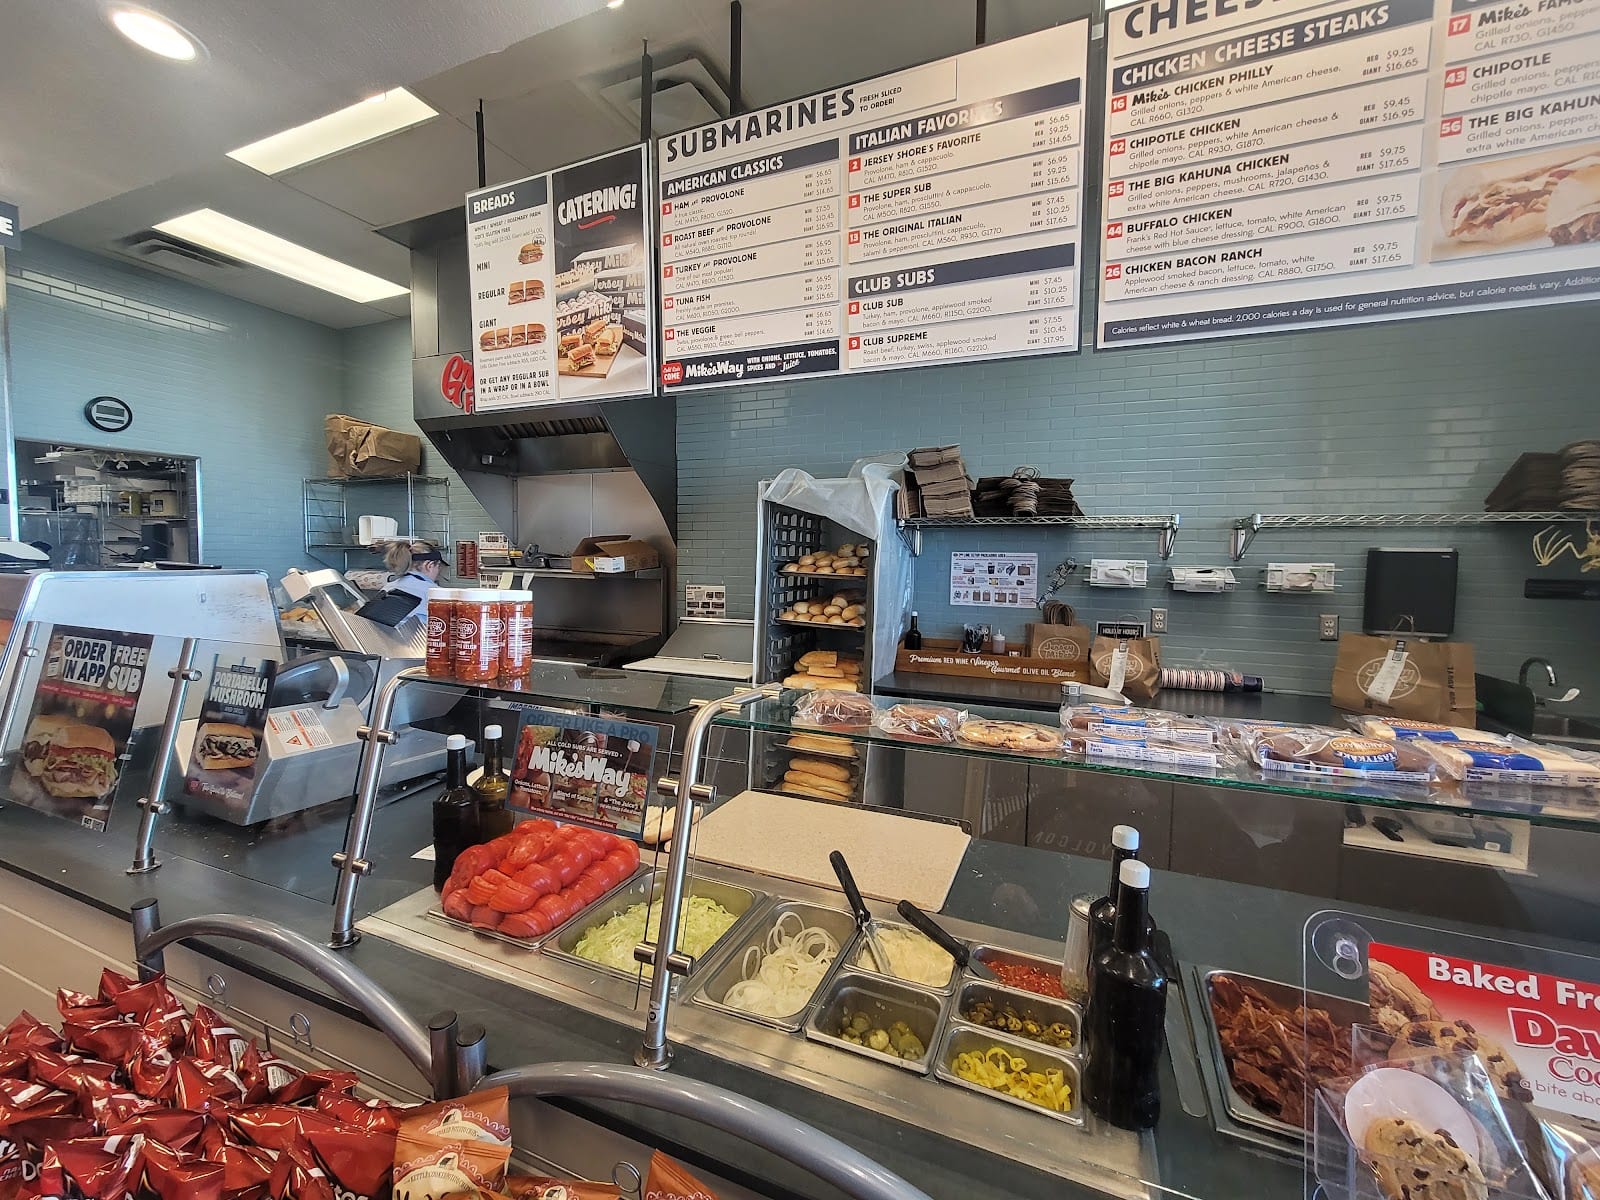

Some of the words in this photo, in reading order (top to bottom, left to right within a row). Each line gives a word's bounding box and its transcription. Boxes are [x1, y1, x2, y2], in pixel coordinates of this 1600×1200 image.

[1452, 21, 1465, 30] 17
[1478, 3, 1532, 27] Mike's
[1122, 50, 1212, 86] CHICKEN
[1215, 29, 1295, 63] CHEESE
[1303, 5, 1389, 43] STEAKS
[1387, 46, 1414, 59] $9.25
[1362, 66, 1381, 76] GIANT
[1386, 58, 1418, 72] $16.65
[1447, 72, 1465, 82] 43
[1472, 52, 1551, 78] CHIPOTLE
[860, 93, 879, 103] FRESH
[881, 87, 902, 98] SLICED
[1112, 101, 1125, 110] 16
[1132, 89, 1170, 106] Mike's
[1174, 76, 1224, 96] CHICKEN
[1229, 65, 1274, 84] PHILLY
[1131, 105, 1156, 117] Grilled
[1159, 100, 1186, 111] onions,
[1189, 91, 1222, 105] peppers
[1235, 84, 1258, 94] white
[1262, 75, 1302, 88] American
[1306, 65, 1341, 78] cheese.
[860, 104, 868, 112] TO
[870, 98, 895, 110] ORDER!
[1384, 97, 1410, 109] $9.45
[667, 89, 855, 162] SUBMARINES
[1360, 116, 1379, 124] GIANT
[1382, 109, 1414, 122] $16.95
[1441, 121, 1461, 133] 56
[1469, 115, 1499, 129] THE
[1505, 107, 1533, 122] BIG
[855, 124, 912, 150] ITALIAN
[1111, 142, 1125, 152] 42
[1130, 131, 1185, 148] CHIPOTLE
[1190, 119, 1241, 137] CHICKEN
[864, 153, 894, 167] JERSEY
[897, 144, 934, 160] SHORE'S
[937, 133, 981, 150] FAVORITE
[667, 169, 727, 196] AMERICAN
[731, 156, 783, 180] CLASSICS
[1109, 184, 1123, 195] 55
[1128, 180, 1150, 191] THE
[1154, 175, 1175, 187] BIG
[1179, 165, 1231, 182] KAHUNA
[1236, 154, 1289, 172] CHICKEN
[473, 191, 515, 215] BREADS
[558, 184, 637, 226] CATERING!
[675, 201, 689, 211] HAM
[701, 188, 745, 204] PROVOLONE
[864, 194, 880, 204] THE
[883, 188, 911, 200] SUPER
[914, 183, 932, 193] SUB
[675, 232, 695, 242] ROAST
[698, 228, 714, 237] BEEF
[727, 216, 771, 231] PROVOLONE
[863, 229, 880, 239] THE
[883, 222, 925, 236] ORIGINAL
[928, 214, 962, 228] ITALIAN
[1108, 226, 1121, 236] 44
[1127, 217, 1178, 233] BUFFALO
[1183, 208, 1232, 224] CHICKEN
[477, 262, 490, 271] MINI
[676, 263, 700, 274] TURKEY
[713, 252, 757, 267] PROVOLONE
[1106, 268, 1120, 277] 26
[1125, 260, 1172, 275] CHICKEN
[1176, 255, 1216, 269] BACON
[1222, 248, 1263, 262] RANCH
[854, 276, 891, 294] CLUB
[897, 269, 935, 288] SUBS
[478, 288, 505, 300] REGULAR
[676, 296, 693, 305] TUNA
[696, 294, 710, 302] FISH
[851, 304, 856, 312] 8
[863, 301, 883, 310] CLUB
[887, 298, 904, 307] SUB
[1112, 326, 1137, 335] Calories
[1139, 323, 1159, 332] reflect
[1161, 321, 1180, 330] white
[1182, 319, 1186, 327] &
[1189, 318, 1210, 327] wheat
[1212, 315, 1233, 325] bread.
[1236, 312, 1260, 323] 2,000
[1263, 309, 1290, 319] calories
[1299, 307, 1313, 317] day
[1316, 306, 1322, 314] is
[1324, 303, 1343, 313] used
[1345, 302, 1356, 311] for
[1358, 298, 1388, 312] general
[1390, 295, 1424, 306] nutrition
[1427, 291, 1456, 302] advice,
[1459, 288, 1474, 298] but
[1477, 286, 1506, 296] calorie
[1509, 283, 1536, 293] needs
[1539, 281, 1562, 292] vary.
[479, 319, 497, 328] GIANT
[677, 329, 689, 337] THE
[691, 326, 716, 335] VEGGIE
[851, 340, 857, 348] 9
[863, 336, 884, 346] CLUB
[887, 331, 928, 344] SUPREME
[64, 639, 106, 662] ORDER
[114, 645, 146, 666] FREE
[910, 654, 942, 663] Premium
[970, 656, 999, 668] Vinegar
[64, 659, 74, 680] IN
[77, 662, 105, 683] APP
[108, 665, 141, 692] SUB
[213, 672, 268, 692] PORTABELLA
[991, 665, 1020, 675] Gourmet
[1040, 668, 1049, 676] OIL
[1051, 668, 1077, 677] Blend
[210, 686, 266, 709] MUSHROOM
[527, 714, 571, 726] ORDER
[574, 718, 604, 732] LIKE
[609, 723, 617, 734] A
[619, 727, 649, 742] PRO
[598, 749, 619, 758] SERVED
[1338, 751, 1397, 763] TASTYKAKE
[1428, 956, 1541, 1000] Baked
[1520, 1079, 1531, 1089] a
[1536, 1076, 1568, 1098] bite
